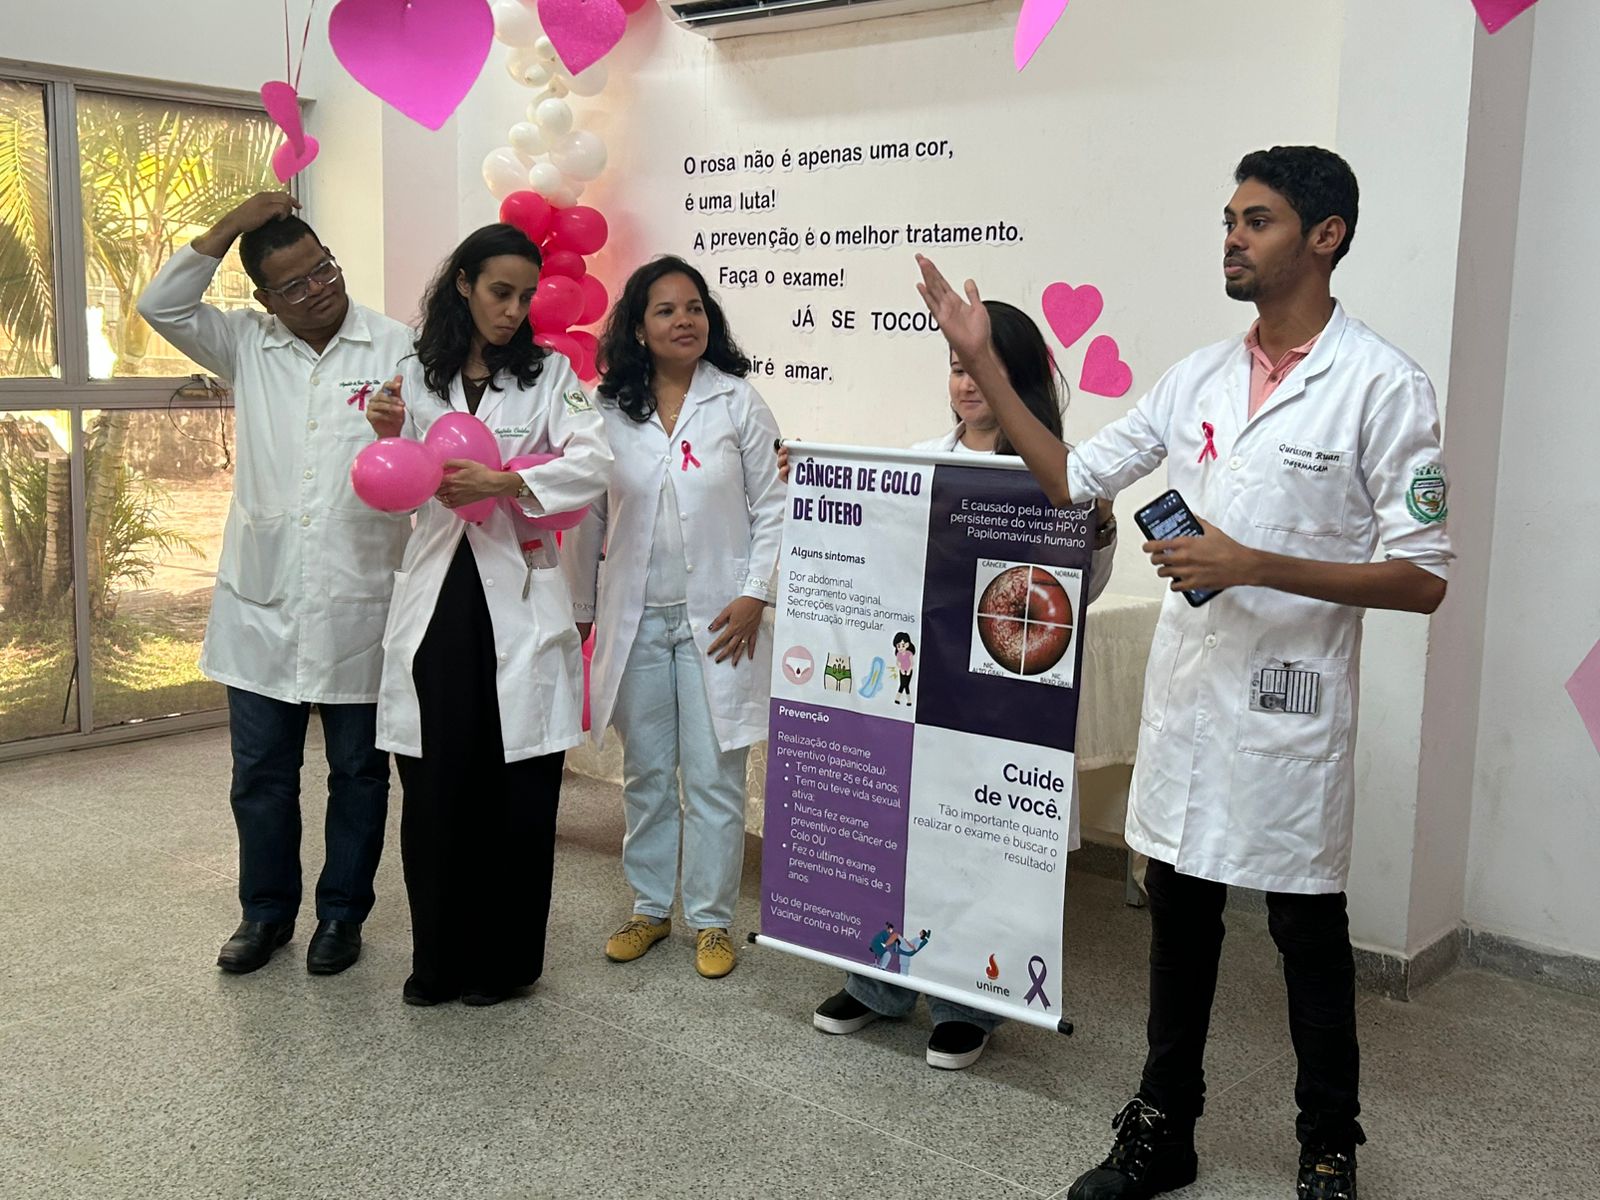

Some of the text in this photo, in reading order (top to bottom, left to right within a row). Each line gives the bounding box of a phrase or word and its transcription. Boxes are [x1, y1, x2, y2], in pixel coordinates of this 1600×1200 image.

[684, 139, 954, 175] O rosa não é apenas uma cor,
[685, 189, 776, 211] é uma luta!
[693, 220, 1024, 251] A prevenção é o melhor tratamento.
[719, 266, 845, 289] Faça o exame!
[792, 304, 814, 327] JÁ
[832, 309, 855, 329] SE
[785, 364, 832, 381] amar.
[795, 457, 922, 496] CÂNCER DE COLO
[793, 494, 862, 526] DE ÚTERO
[971, 502, 1016, 514] causado
[1018, 505, 1041, 517] pela
[950, 513, 1008, 527] persistente
[1011, 517, 1025, 528] do
[1056, 521, 1078, 533] HPV
[1080, 526, 1087, 535] o
[791, 546, 866, 564] Alguns sintomas
[1044, 534, 1085, 549] humano
[788, 583, 847, 601] Sangramento
[789, 570, 853, 589] Dor abdominal
[786, 608, 843, 625] Menstruação
[787, 596, 916, 623] Secreções vaginais anormais
[779, 705, 830, 723] Prevenção
[777, 746, 826, 762] preventivo
[778, 730, 871, 758] Realização do exame
[796, 761, 817, 774] Tem
[819, 768, 842, 780] entre
[843, 773, 853, 784] 25
[855, 776, 860, 785] e
[862, 776, 873, 789] 64
[1003, 763, 1064, 793] Cuide
[795, 775, 901, 808] Tem ou teve vida sexual
[974, 784, 1062, 820] de você.
[794, 802, 869, 829] Nunca fez exame
[938, 803, 1059, 841] Tão importante quanto
[790, 828, 826, 846] Colo OU
[791, 817, 897, 850] preventivo de Câncer de
[913, 815, 1057, 857] realizar o exame é buscar o
[792, 843, 807, 855] Fez
[809, 849, 815, 857] o
[846, 859, 876, 873] exame
[1004, 851, 1056, 873] resultado!
[788, 871, 809, 883] anos
[789, 857, 833, 876] preventivo
[849, 873, 869, 886] mais
[871, 879, 883, 889] de
[885, 882, 891, 893] 3
[770, 905, 801, 922] Vacinar
[803, 916, 830, 931] contra
[832, 925, 839, 933] o
[771, 892, 861, 925] Uso de preservativos
[976, 980, 1010, 997] unime
